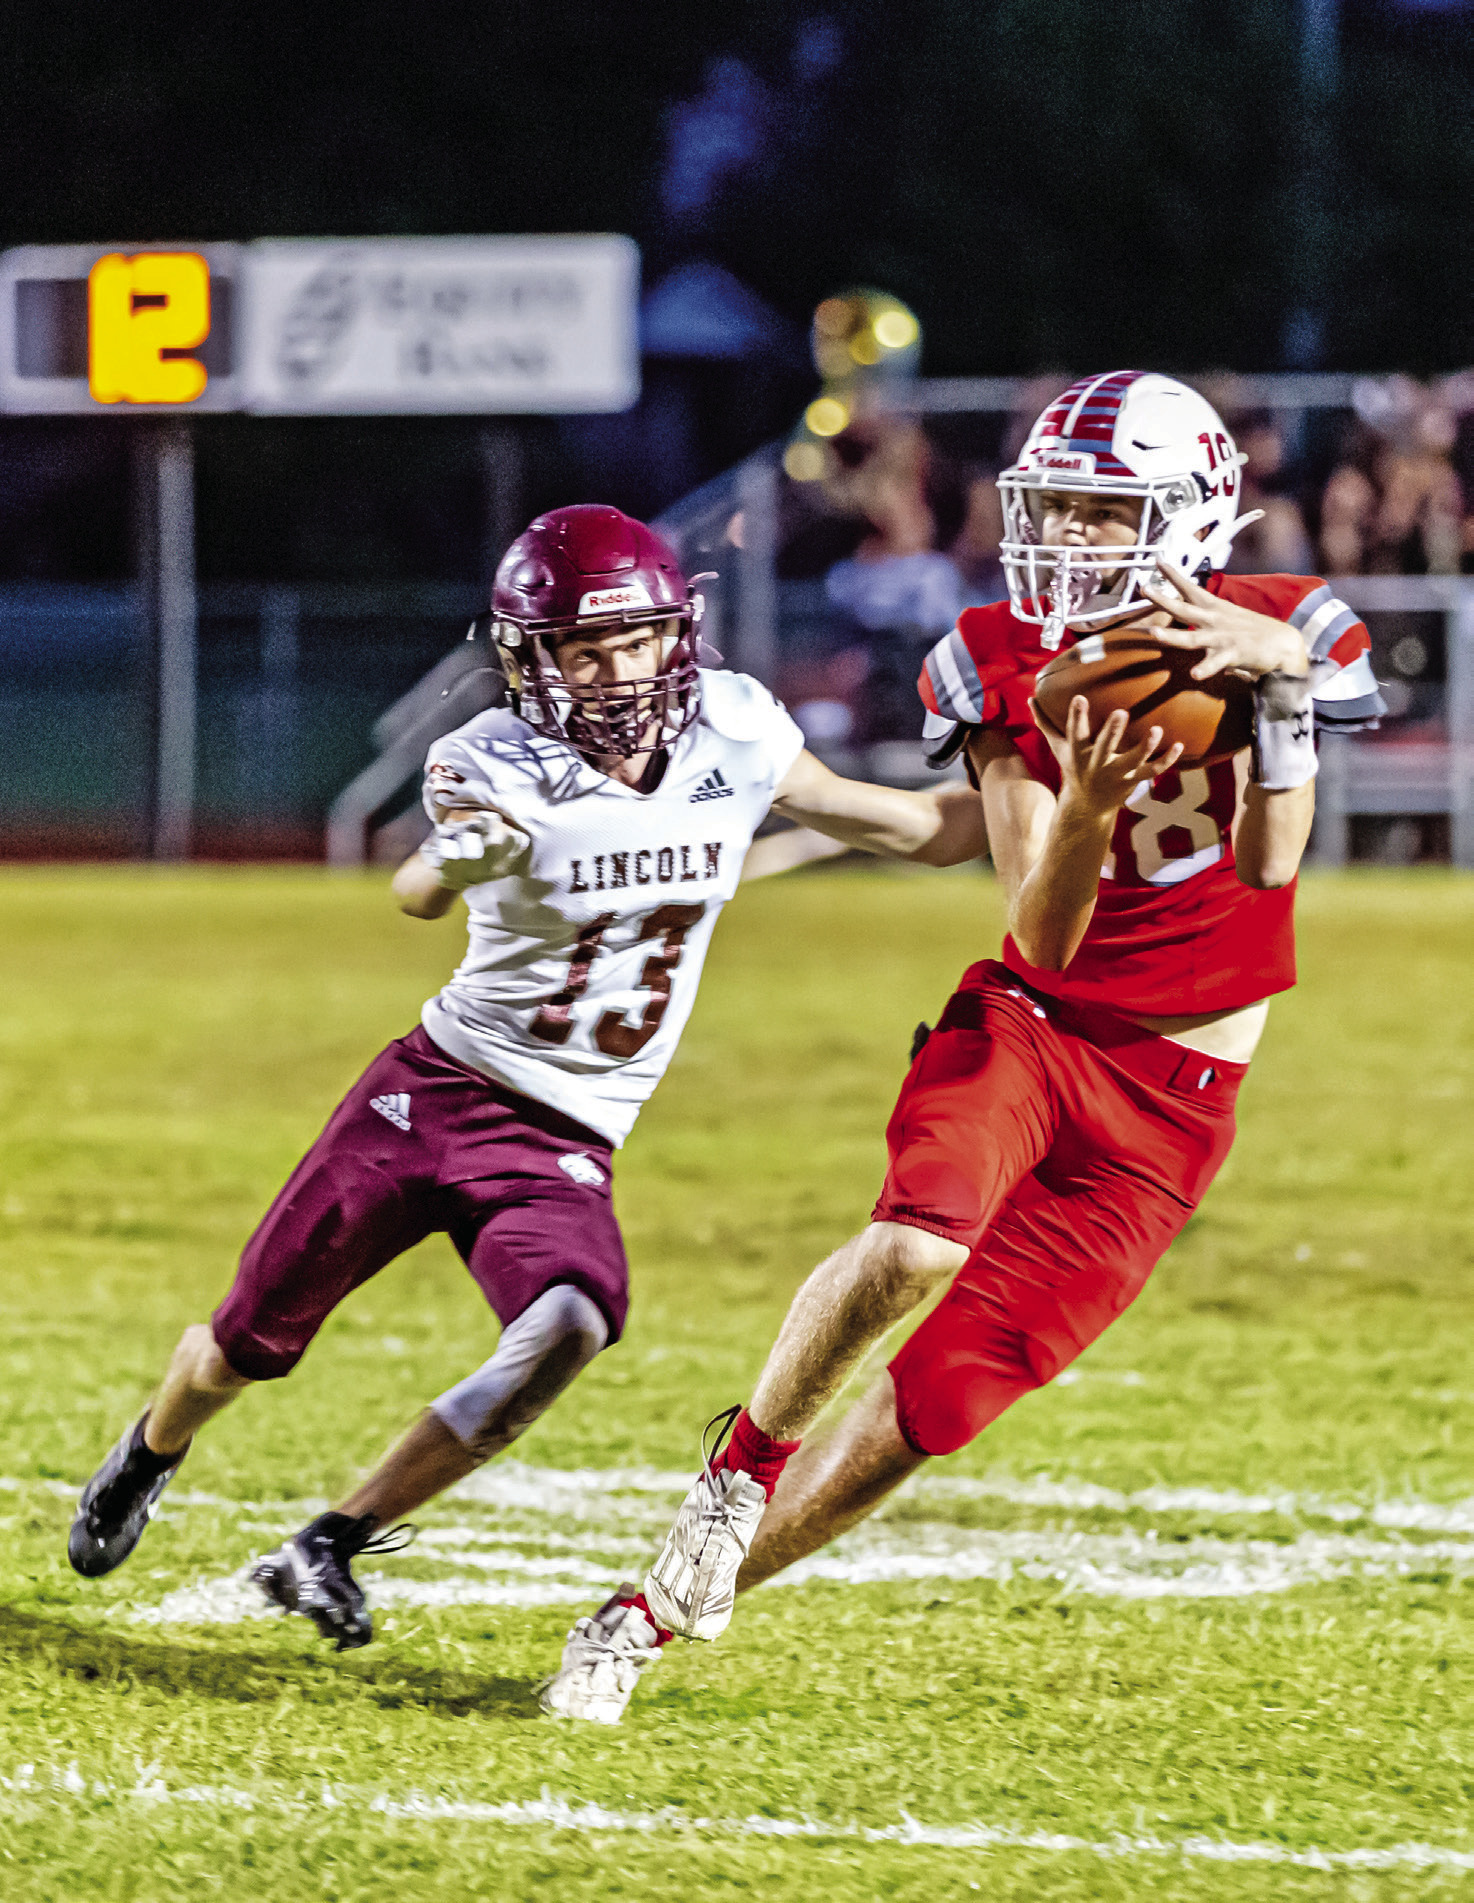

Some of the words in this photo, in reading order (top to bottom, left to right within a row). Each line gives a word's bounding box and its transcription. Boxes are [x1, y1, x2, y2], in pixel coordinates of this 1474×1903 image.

[1037, 456, 1081, 470] Rddell
[589, 592, 640, 607] Ridde
[1100, 768, 1225, 887] 8
[569, 842, 722, 893] LINCOLN
[529, 902, 706, 1058] 13
